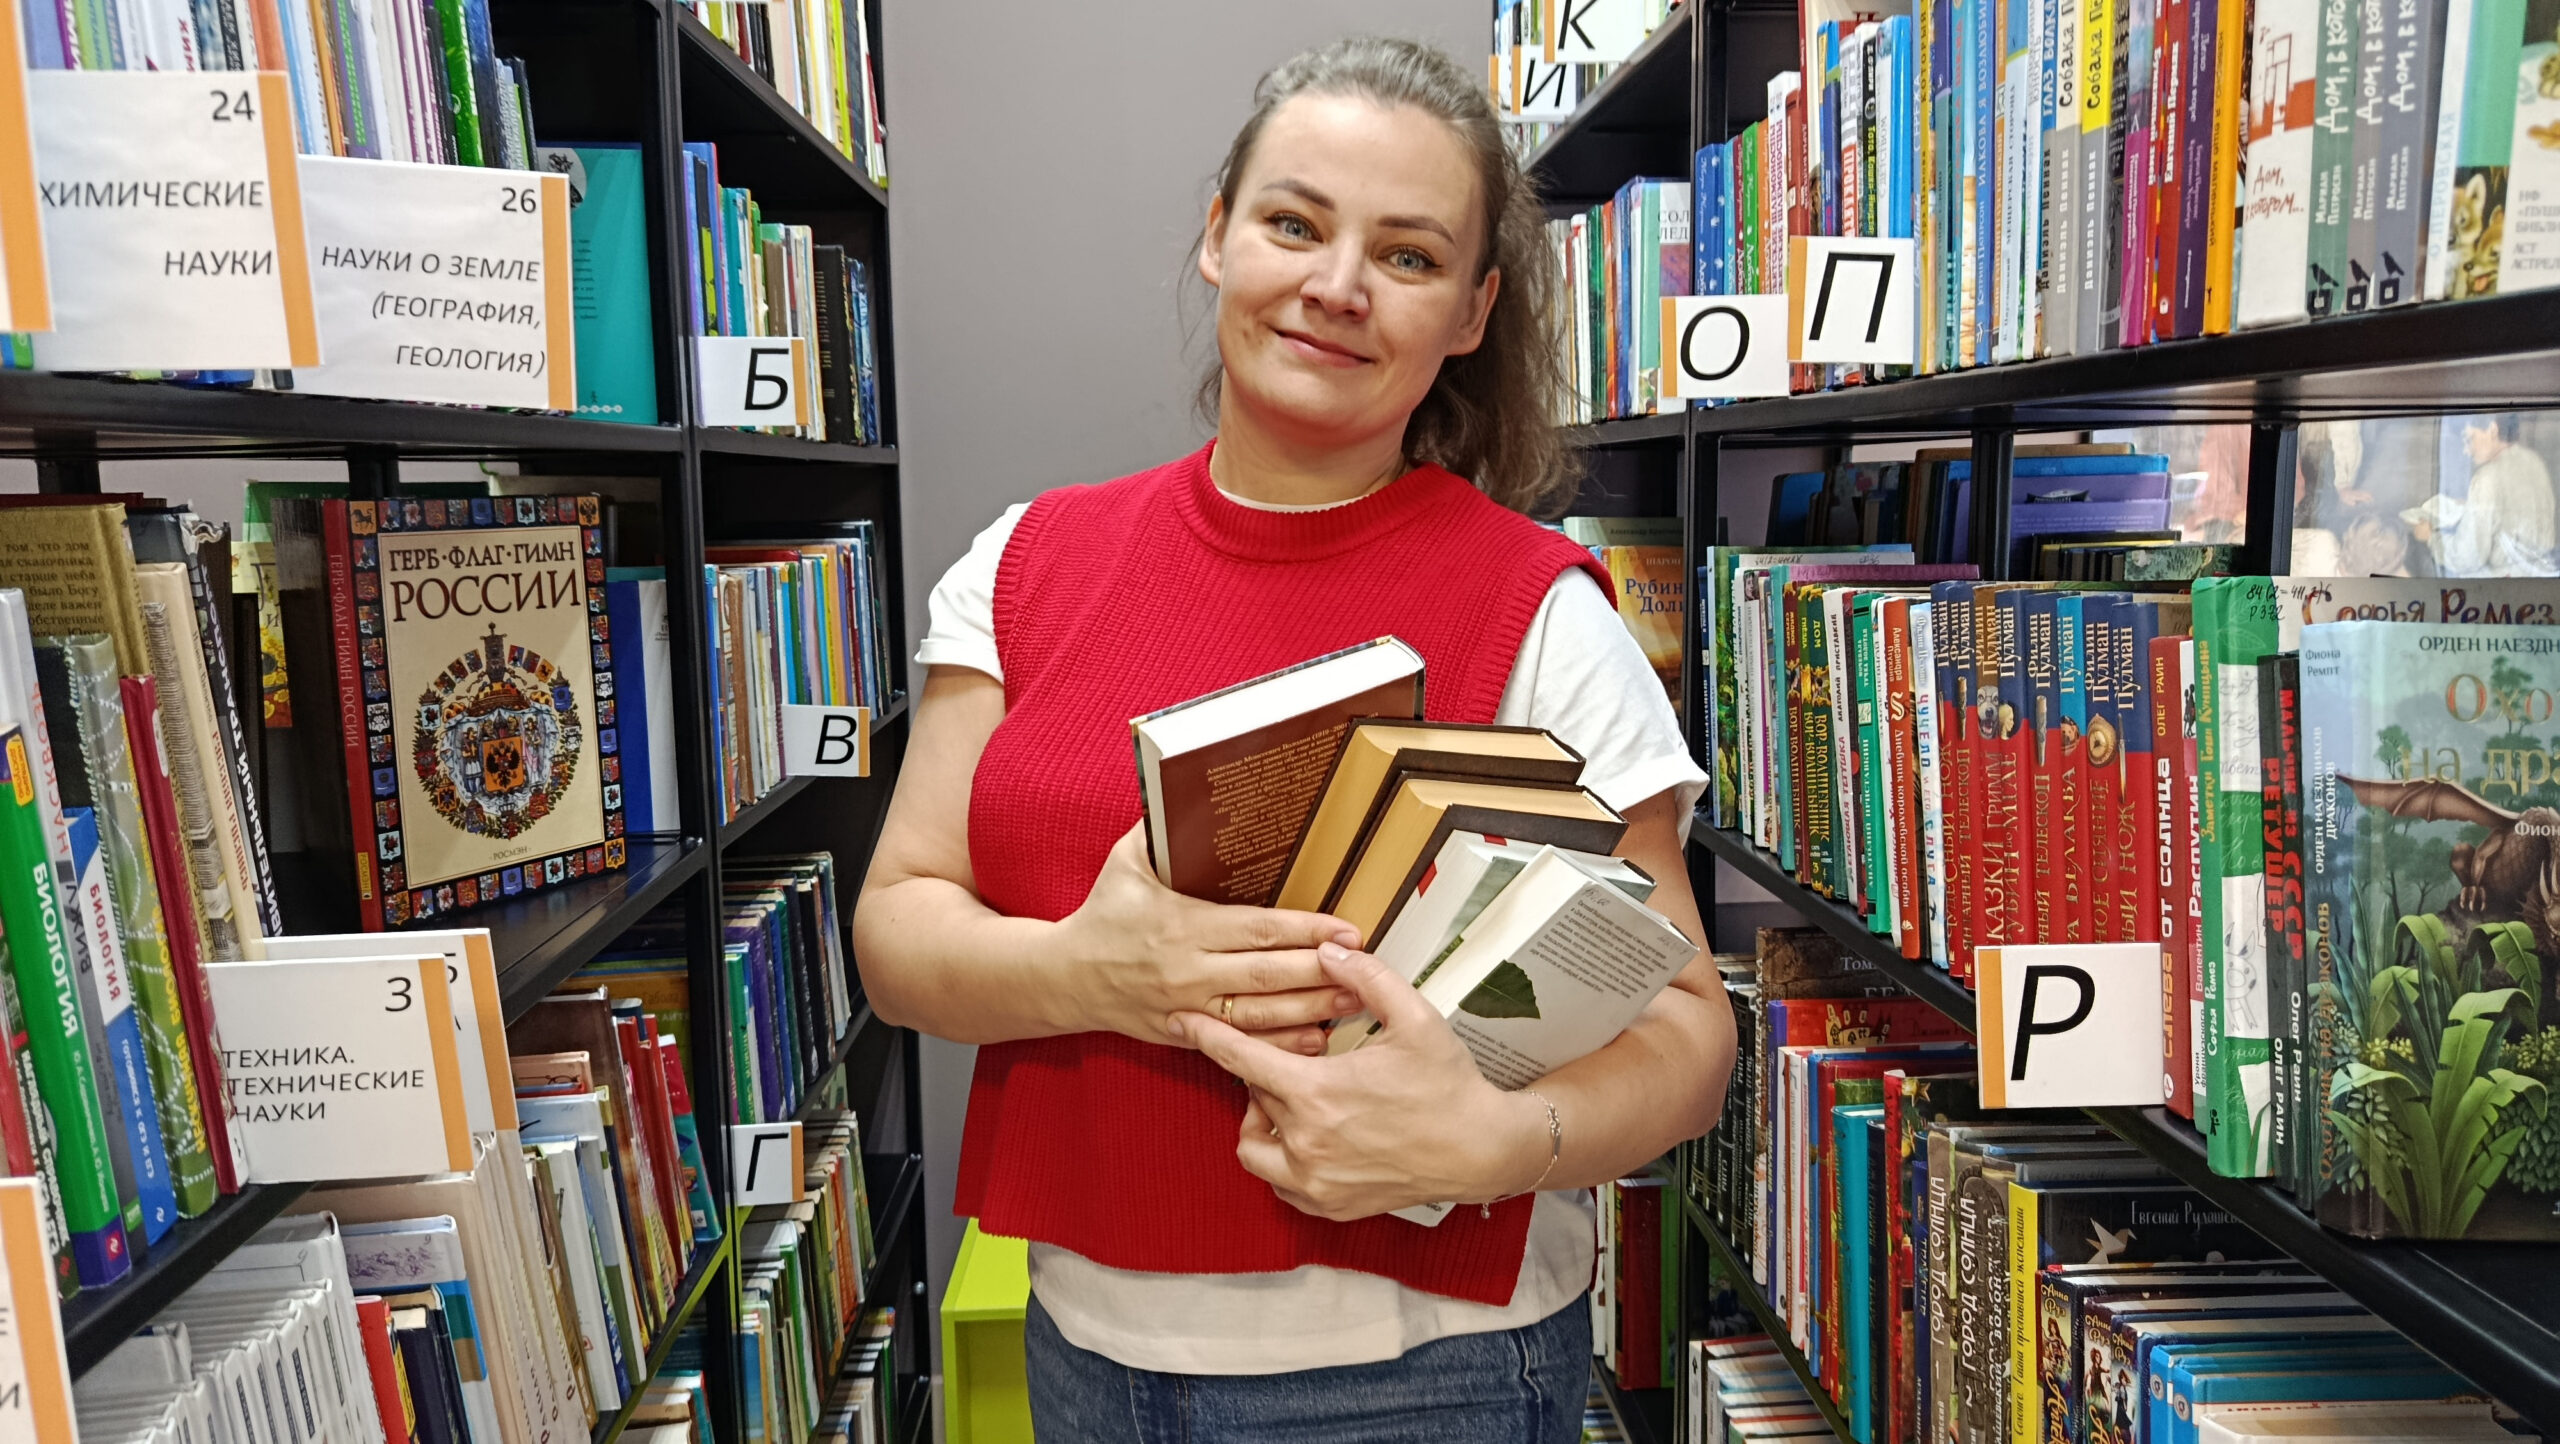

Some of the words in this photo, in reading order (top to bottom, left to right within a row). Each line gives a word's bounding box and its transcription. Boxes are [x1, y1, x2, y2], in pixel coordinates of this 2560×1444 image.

[1558, 0, 1596, 50] К
[1522, 58, 1567, 108] И
[2042, 69, 2055, 118] ГЛАЗ
[2058, 22, 2074, 110] Собака
[2086, 29, 2103, 110] Собака
[2167, 42, 2181, 111] Пермяк
[210, 90, 256, 122] 24
[2057, 147, 2069, 212] Пеннак
[2084, 150, 2096, 212] Пеннак
[2163, 114, 2178, 184] Евгений
[2386, 153, 2399, 210] Мариам
[2396, 146, 2410, 211] Петросян
[39, 181, 264, 208] ХИМИЧЕСКИЕ
[501, 187, 537, 213] 26
[164, 250, 273, 276] НАУКИ
[322, 246, 412, 273] НАУКИ
[421, 253, 441, 273] О
[448, 255, 541, 282] ЗЕМЛЕ
[2056, 220, 2068, 294] Даниэль
[2083, 218, 2096, 291] Даниэль
[372, 291, 541, 329] (ГЕОГРАФИЯ,
[1808, 250, 1896, 344] П
[396, 345, 547, 378] ГЕОЛОГИЯ)
[1680, 305, 1750, 381] О
[744, 347, 790, 411] Б
[389, 568, 582, 622] РОССИИ
[1948, 601, 1960, 654] Филип
[201, 562, 244, 749] ТРАНСПОРТ
[1813, 620, 1822, 649] ДОМ
[1887, 644, 1895, 681] Птухина
[1892, 627, 1903, 681] Александра
[1936, 600, 1949, 669] Пулман
[1956, 600, 1971, 671] Пулман
[1981, 603, 1999, 678] Пулман
[1998, 605, 2015, 678] Пулман
[2025, 613, 2039, 678] Филип
[2035, 611, 2051, 689] Пулман
[2058, 615, 2074, 694] Пулман
[2084, 622, 2096, 691] Филип
[2091, 620, 2109, 703] Пулман
[2305, 647, 2342, 660] Фиона
[2419, 635, 2481, 653] ОРДЕН
[2117, 626, 2134, 710] Пулман
[2155, 656, 2165, 694] РАИН
[2197, 641, 2213, 723] Куницына
[2445, 673, 2560, 724] Охо
[341, 686, 361, 748] РОССИИ
[814, 714, 858, 766] В
[1918, 693, 1933, 768] ЧУЧЕЛО
[2156, 703, 2166, 737] ОЛЕГ
[2199, 729, 2213, 762] Гоши
[2279, 689, 2299, 794] МАЛЬЧИК
[1789, 706, 1801, 829] ВОР-ВОЛШЕБНИК
[1815, 713, 1830, 843] ВОР-ВОЛШЕБНИК
[1838, 734, 1850, 794] ТЕТУШКА
[1894, 729, 1905, 778] Дневник
[2312, 726, 2324, 822] НАЕЗДНИКОВ
[2399, 746, 2463, 784] на
[1897, 781, 1908, 864] королевской
[1956, 748, 1972, 844] ТЕЛЕСКОП
[2036, 774, 2051, 879] ТЕЛЕСКОП
[2199, 771, 2216, 843] Заметки
[2284, 810, 2299, 834] ИЗ
[2325, 761, 2337, 840] ДРАКОНОВ
[1925, 819, 1938, 887] СЛУГА
[2118, 801, 2136, 875] НОЖ
[2188, 775, 2202, 919] Распутин
[2262, 756, 2286, 933] РЕТУШЕР
[2314, 826, 2325, 875] ОРДЕН
[1901, 867, 1911, 909] особы
[1984, 841, 2005, 945] КАЗКИ
[2281, 850, 2303, 959] СССР
[32, 861, 80, 1039] БИОЛОГИЯ
[89, 882, 122, 1001] БИОЛОГИЯ
[2194, 924, 2204, 992] Валентин
[385, 976, 413, 1012] 3
[2204, 960, 2218, 1000] Ремез
[2009, 964, 2096, 1081] Р
[2206, 1009, 2218, 1057] Софья
[2291, 990, 2302, 1041] Олег
[221, 1046, 355, 1069] ТЕХНИКА.
[228, 1069, 425, 1096] ТЕХНИЧЕСКИЕ
[2273, 1037, 2285, 1085] ОЛЕГ
[2290, 1050, 2302, 1103] Раин
[234, 1101, 326, 1123] НАУКИ
[2274, 1092, 2286, 1145] РАИН
[744, 1131, 789, 1193] Г
[1929, 1177, 1947, 1262] СОЛНЦА
[1959, 1197, 1977, 1286] СОЛНЦА
[2014, 1207, 2025, 1275] экспедиции
[2131, 1199, 2180, 1226] Евгений
[1930, 1270, 1946, 1345] ГОРОД
[2013, 1279, 2030, 1346] пропавшей
[2041, 1283, 2069, 1302] Анна
[2085, 1314, 2111, 1332] Анна
[1959, 1291, 1977, 1373] ГОРОД
[2013, 1350, 2024, 1386] Тайна
